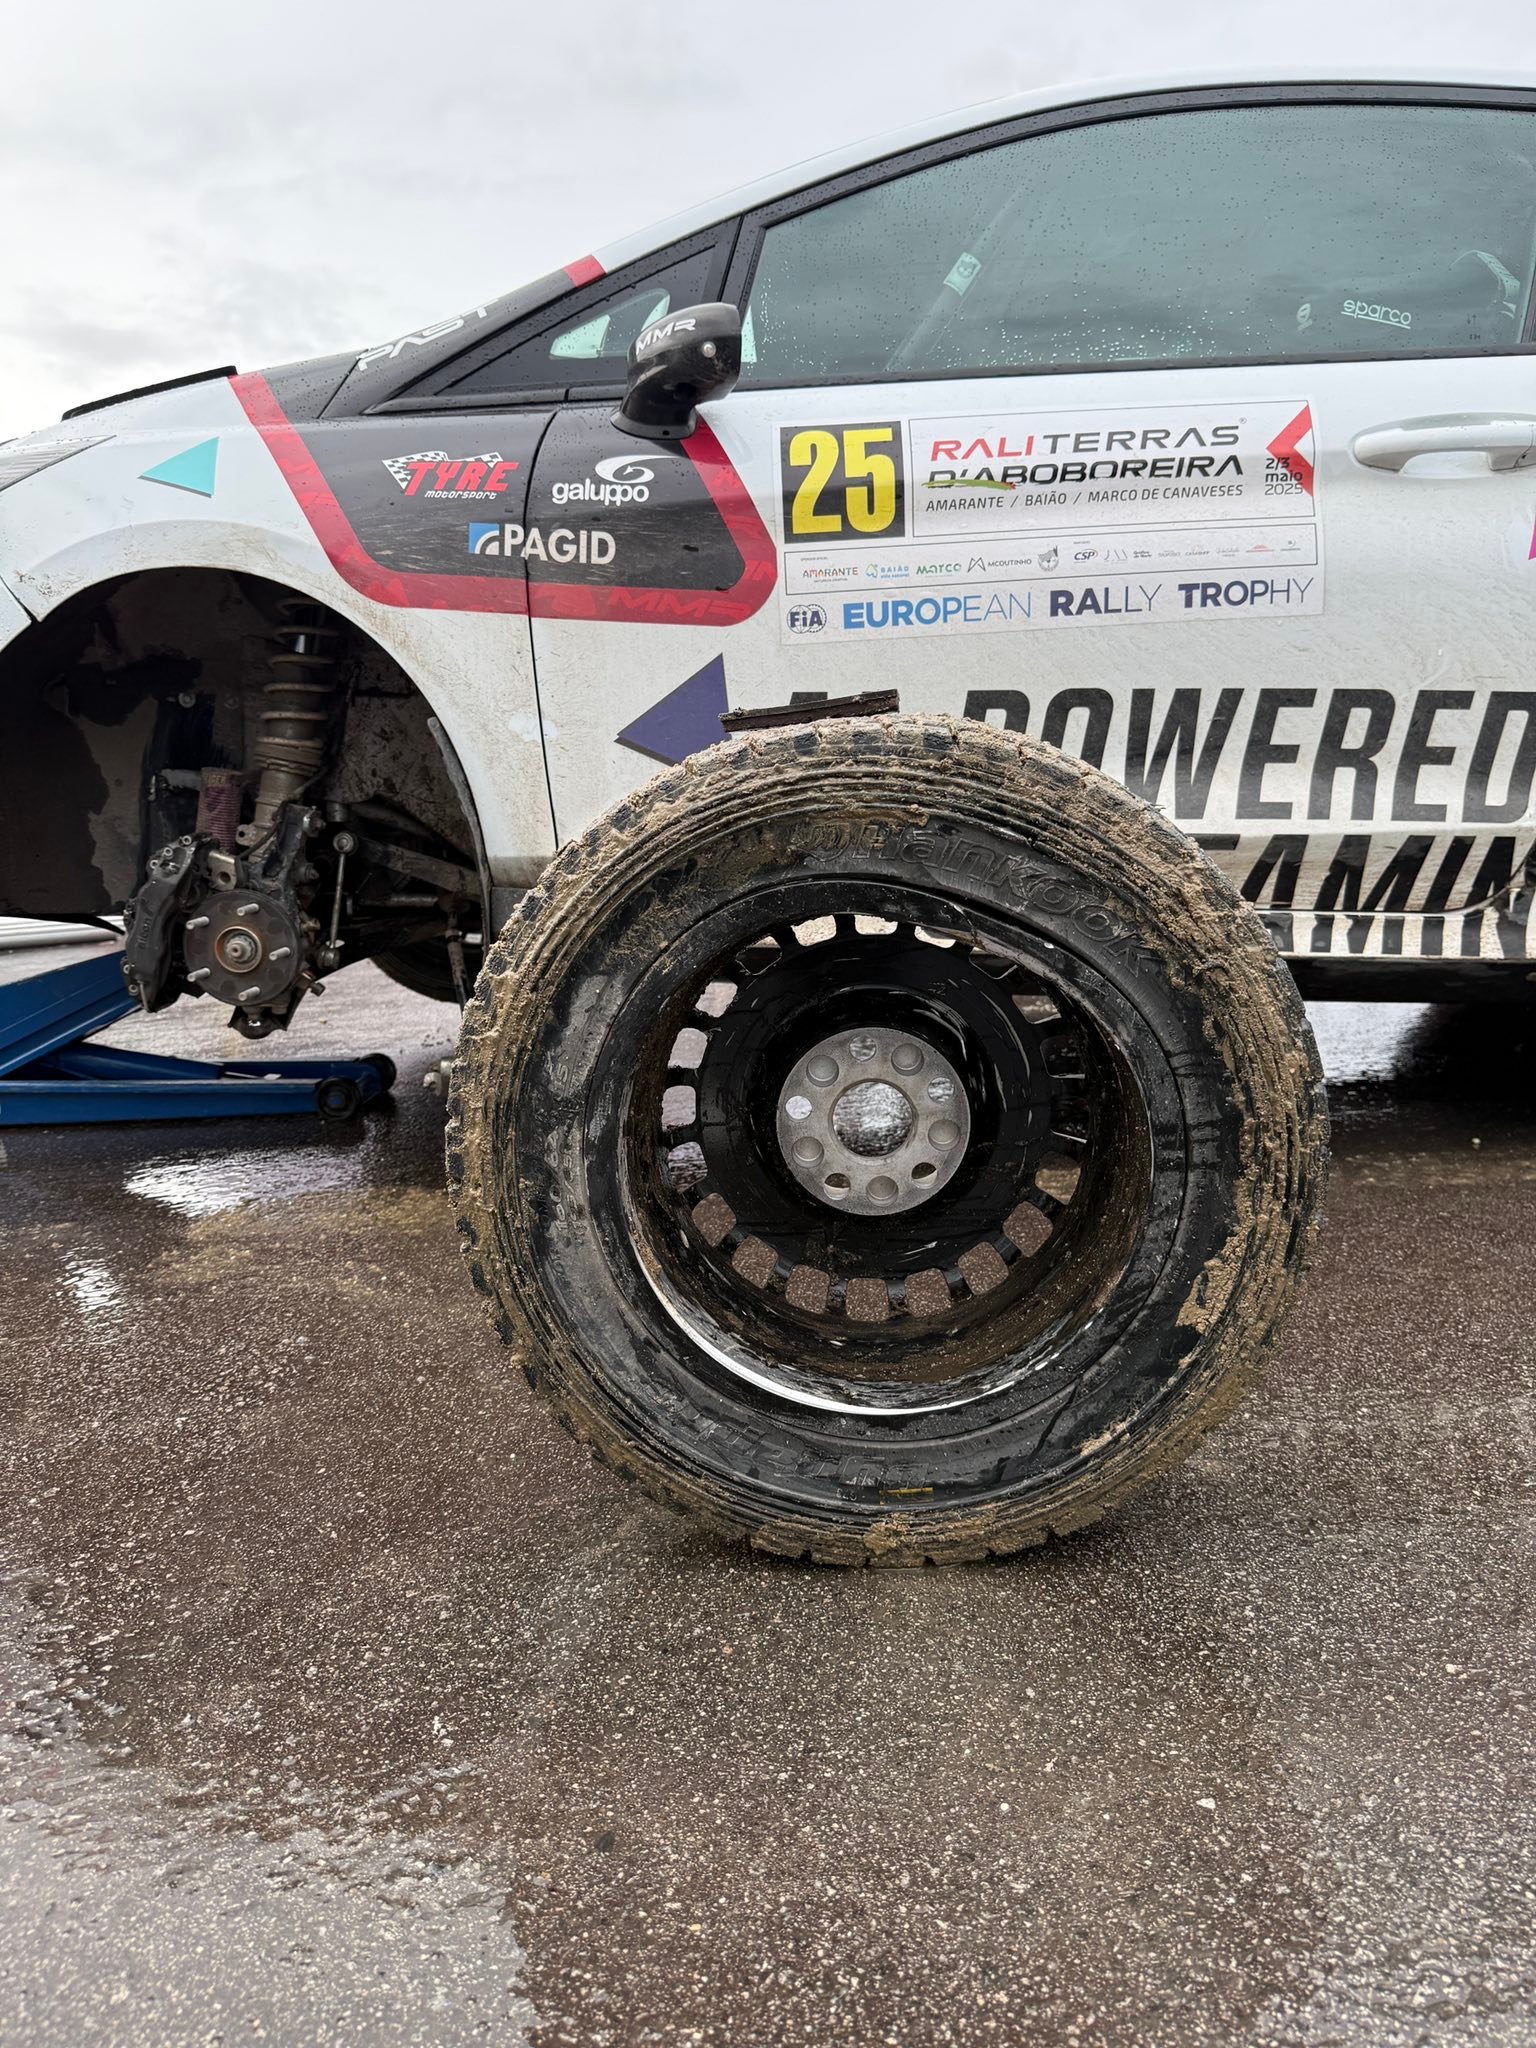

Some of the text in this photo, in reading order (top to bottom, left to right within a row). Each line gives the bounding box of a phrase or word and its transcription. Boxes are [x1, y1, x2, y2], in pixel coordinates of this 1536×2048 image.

[1343, 299, 1412, 326] sparco
[636, 318, 696, 355] MMR
[930, 426, 1240, 462] RALI TERRAS
[928, 454, 1244, 488] D'ABOBOREIRA
[1265, 457, 1290, 470] 2/3
[1265, 471, 1304, 483] maio
[405, 461, 520, 496] TYRE
[552, 478, 650, 506] galuppo
[788, 428, 897, 536] 25
[1265, 483, 1304, 496] 2025
[424, 489, 497, 500] motorsport
[926, 496, 1004, 512] AMARANTE
[1025, 490, 1067, 507] BAIÃO
[1088, 488, 1138, 503] MARCO
[1142, 488, 1159, 501] DE
[1163, 484, 1243, 499] CANAVESES
[504, 523, 617, 565] PAGID
[1074, 551, 1096, 561] CSP
[803, 566, 859, 579] AMARANTE
[988, 558, 1032, 567] MCOUTINHO
[843, 577, 1315, 630] EUROPEAN RALLY TROPHY
